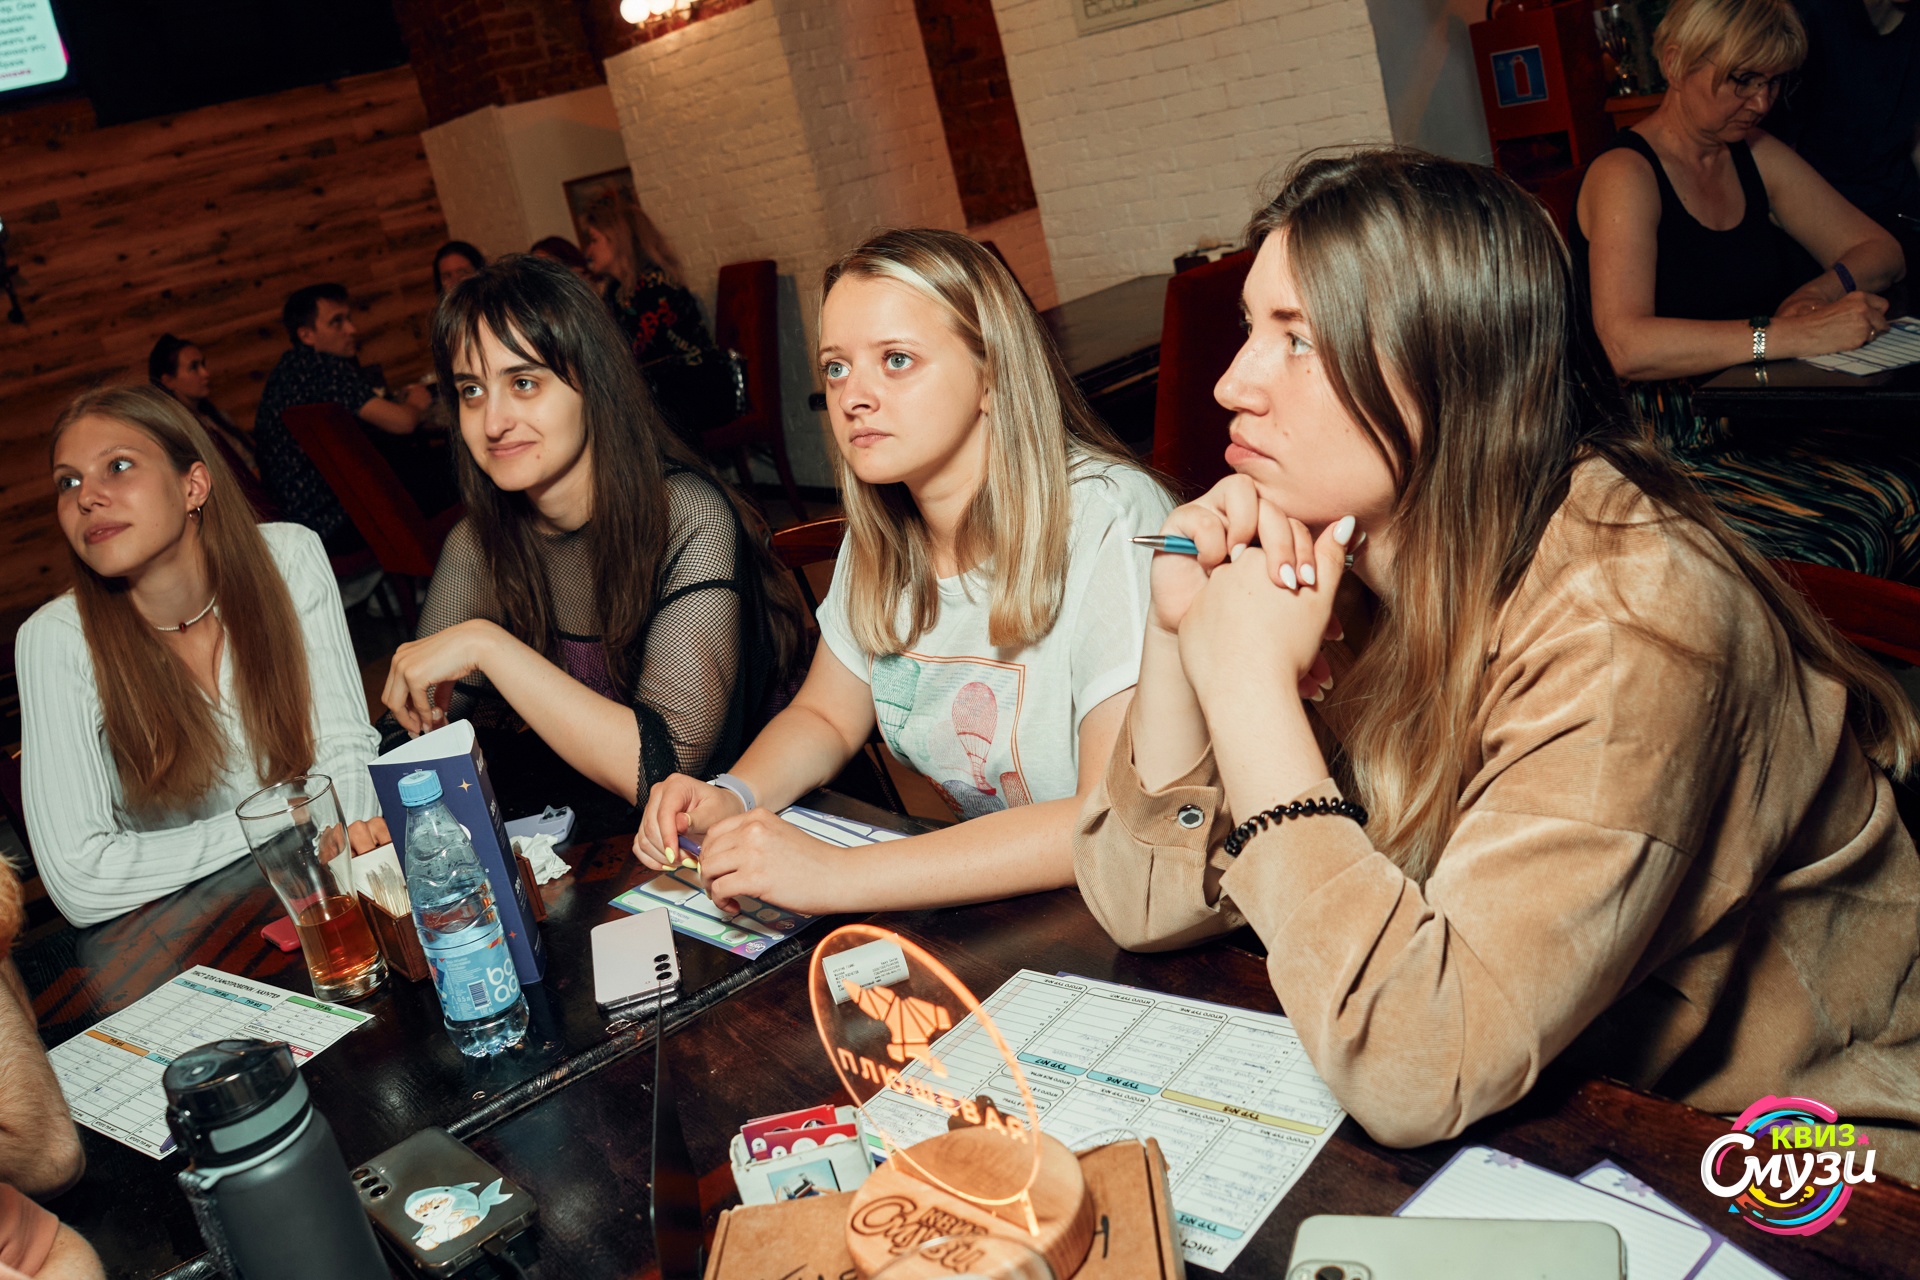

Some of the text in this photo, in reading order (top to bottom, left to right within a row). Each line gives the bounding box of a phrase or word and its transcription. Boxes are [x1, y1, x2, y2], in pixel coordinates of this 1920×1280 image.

[1035, 1058, 1066, 1071] ТУР №7
[1106, 1076, 1140, 1090] ТУР №6
[1222, 1106, 1260, 1121] ТУР №5
[1198, 1222, 1218, 1232] ТУР
[1181, 1238, 1218, 1255] ЛИСТ
